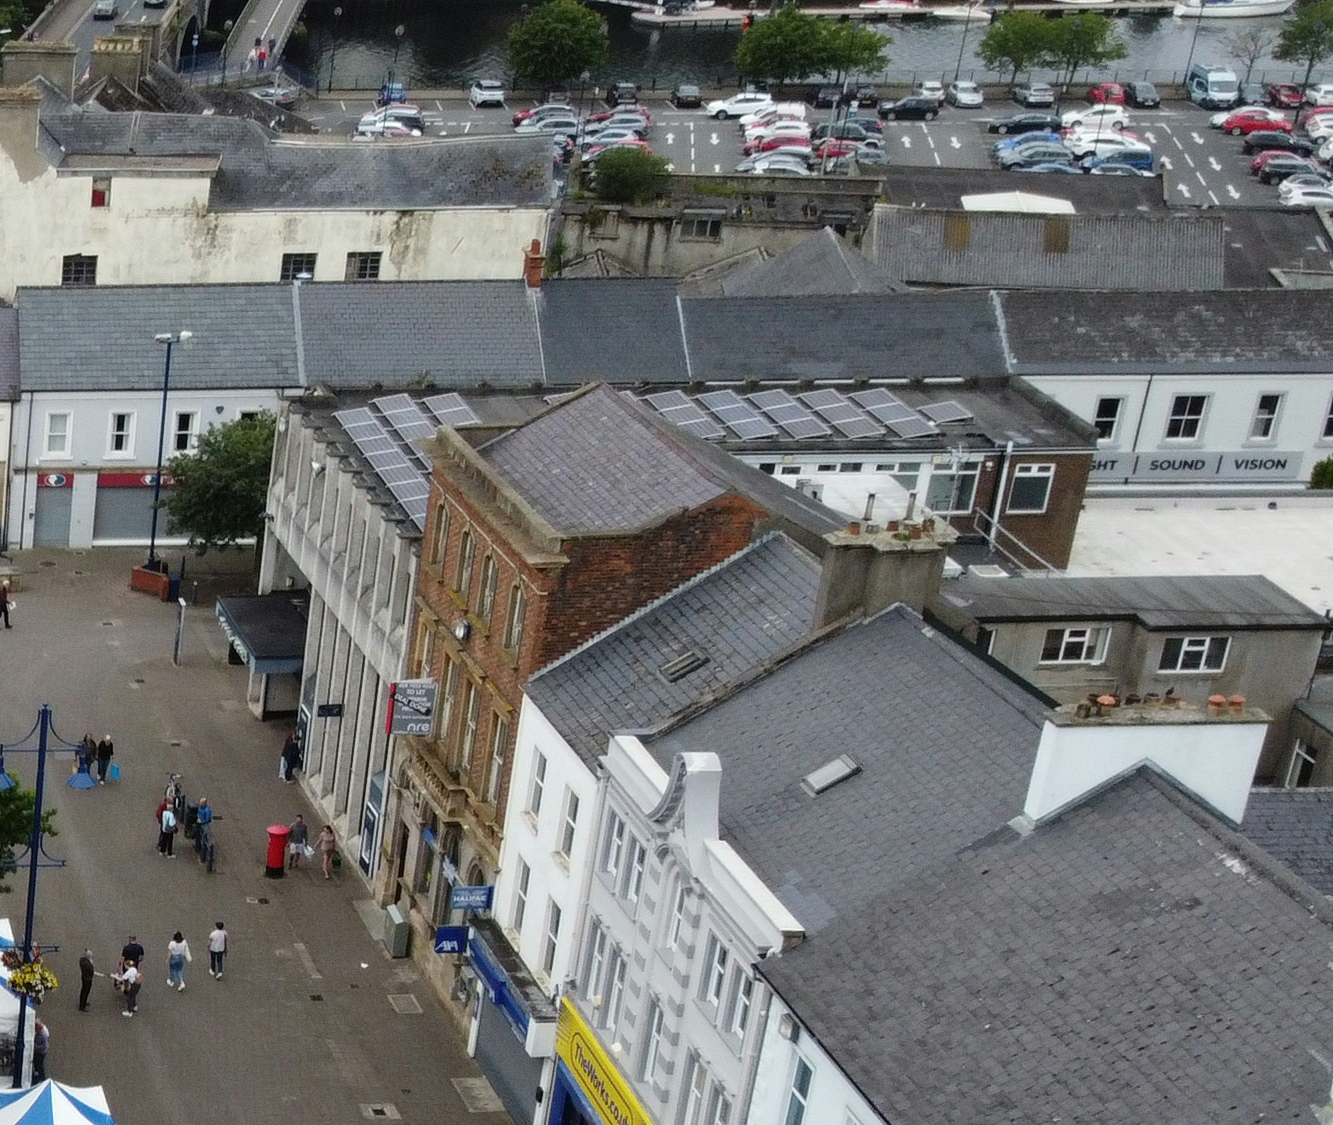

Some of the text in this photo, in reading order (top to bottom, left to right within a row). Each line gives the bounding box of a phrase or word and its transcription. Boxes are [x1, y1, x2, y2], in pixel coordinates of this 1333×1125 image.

[1149, 459, 1205, 471] SOUND
[1234, 459, 1288, 470] VISION
[436, 940, 458, 951] AXA
